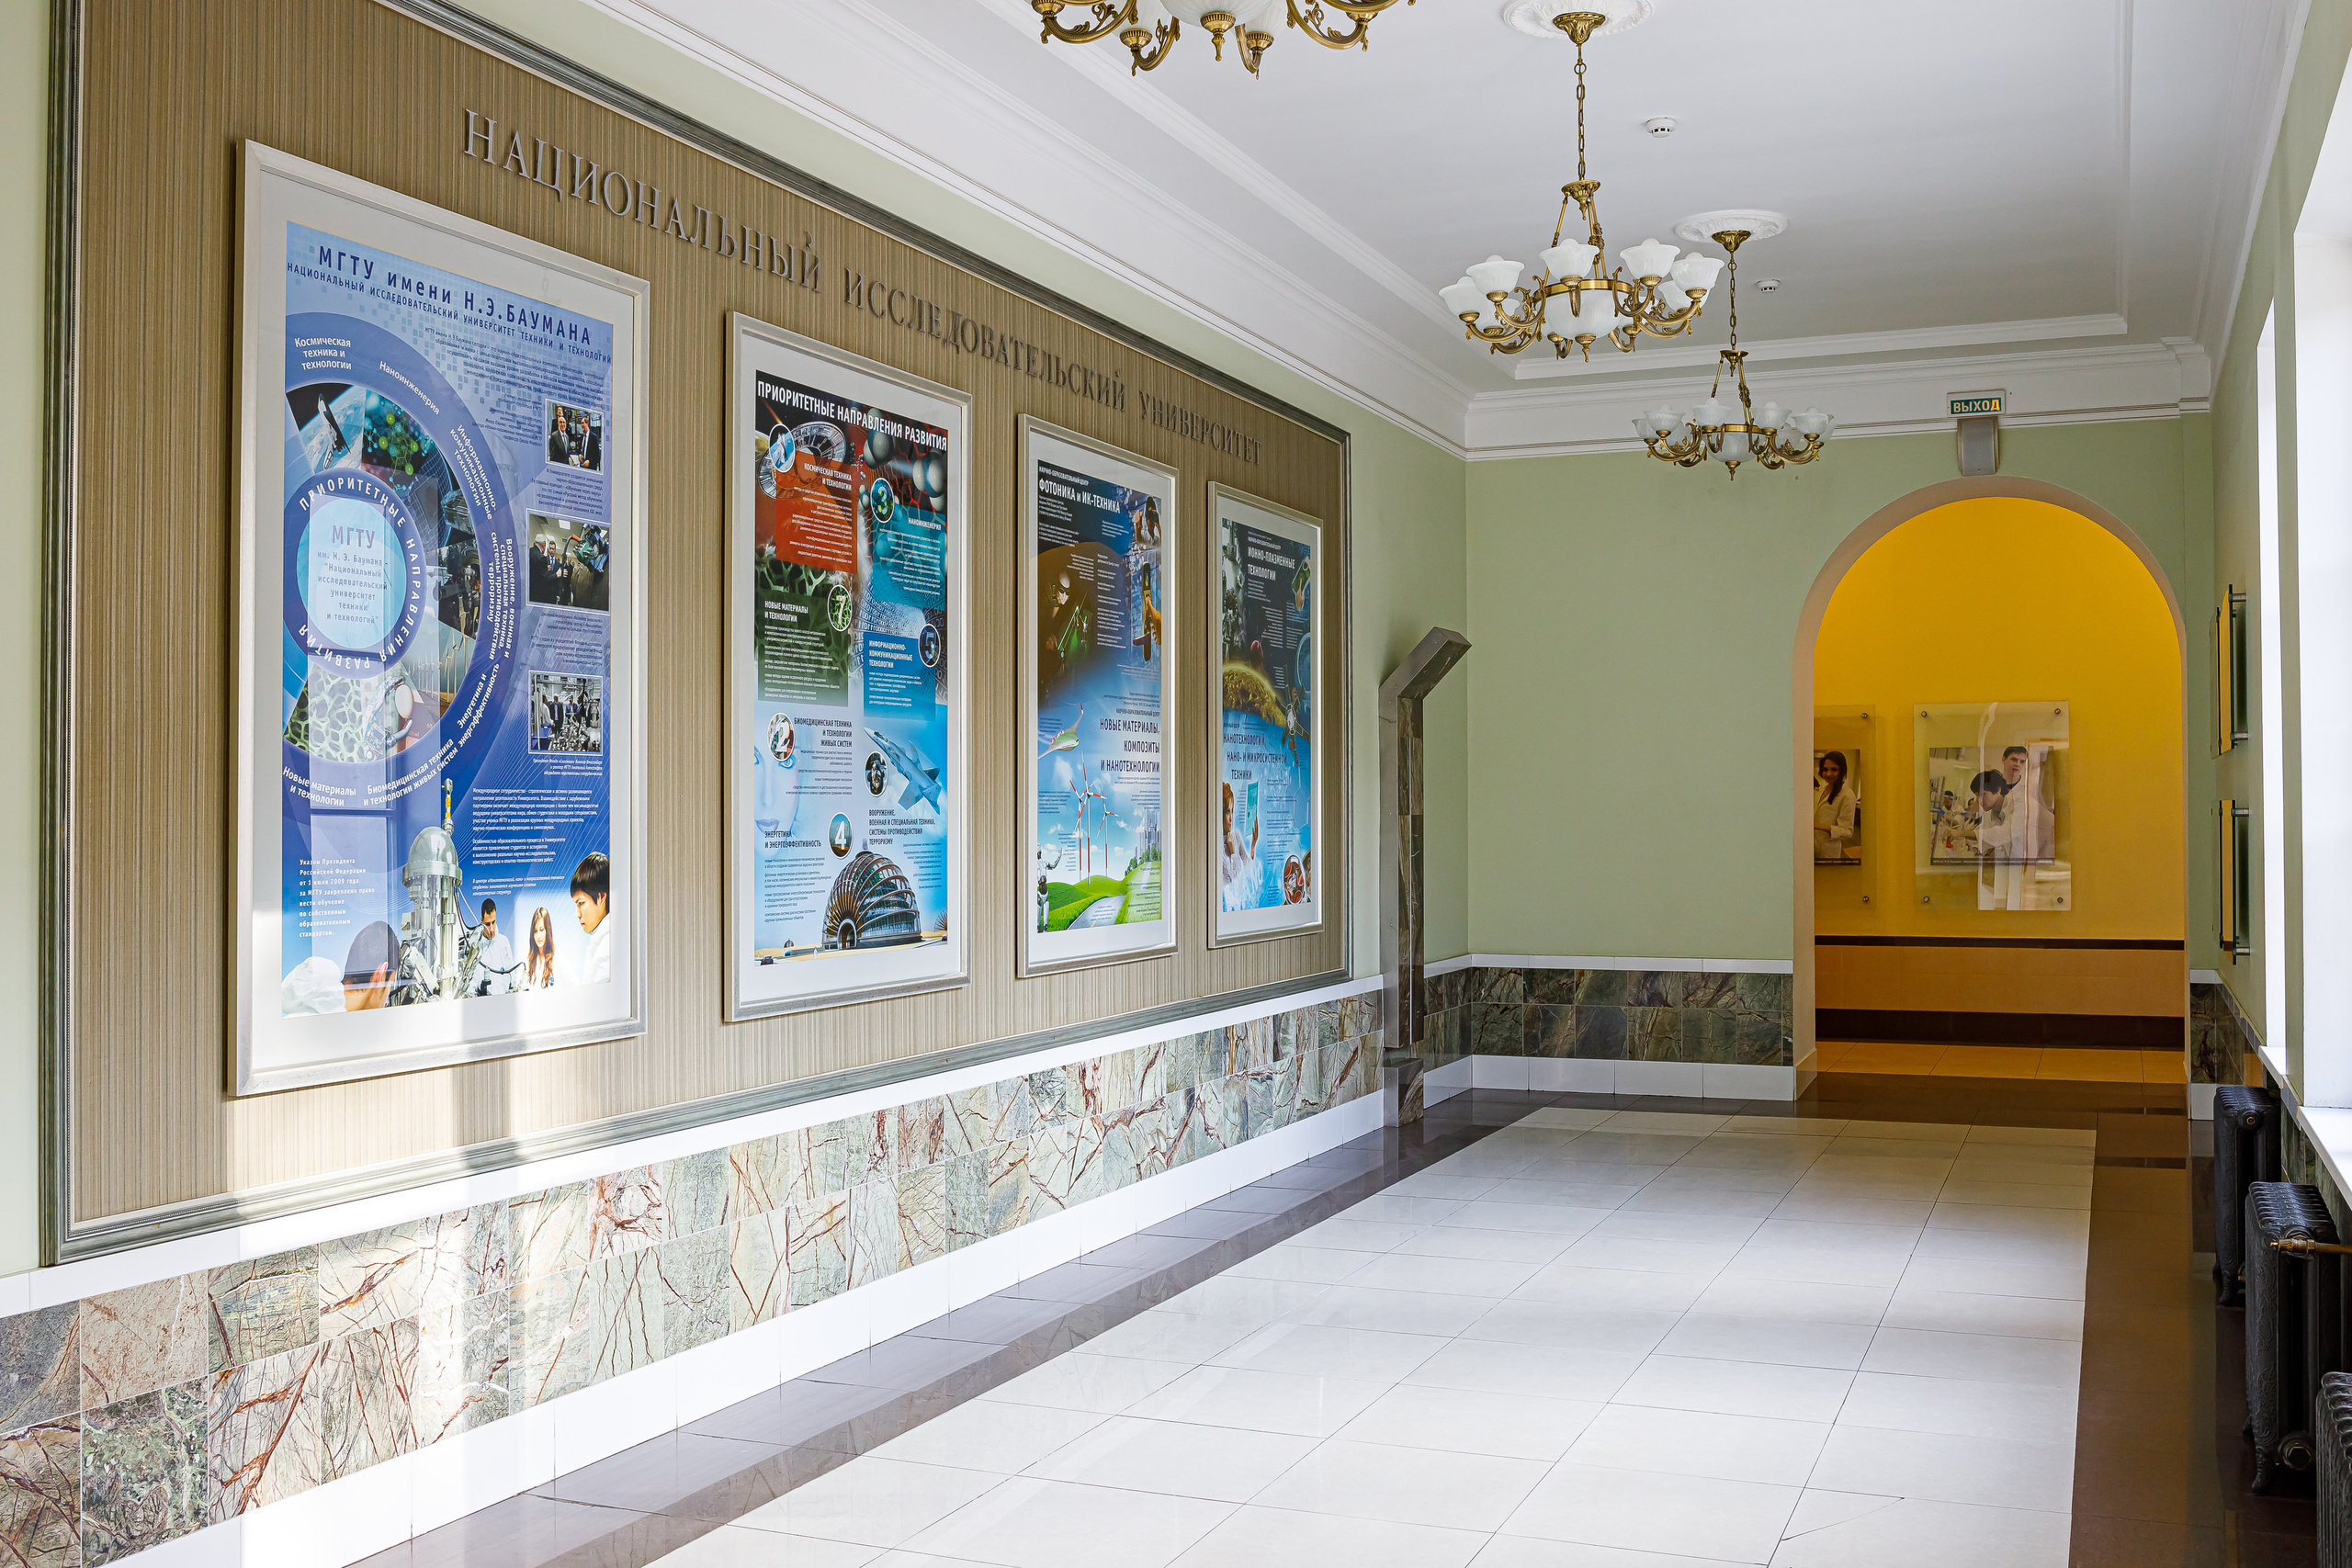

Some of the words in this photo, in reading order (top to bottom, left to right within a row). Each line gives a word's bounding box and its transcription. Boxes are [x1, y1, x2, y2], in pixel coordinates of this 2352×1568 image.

[319, 245, 374, 279] МГТУ
[388, 272, 451, 305] имени
[464, 290, 591, 345] Н.Э.БАУМАНА
[464, 107, 822, 293] НАЦИОНАЛЬНЫЙ
[844, 268, 1126, 412] ИССЛЕДОВАТЕЛЬСКИЙ
[1138, 389, 1263, 466] УНИВЕРСИТЕТ
[287, 262, 365, 292] НАЦИОНАЛЬНЫЙ
[370, 287, 458, 321] ИССЛЕДОВАТЕЛЬСКИЙ
[463, 314, 515, 337] УНИВЕРСИТЕТ
[521, 332, 553, 348] ТЕХНИКИ
[568, 344, 612, 365] ТЕХНОЛОГИЙ
[294, 337, 351, 348] Космическая
[303, 347, 338, 358] техника
[339, 349, 345, 358] и
[301, 360, 352, 370] технологии
[379, 360, 440, 415] Наноинженерия
[757, 380, 835, 419] ПРИОРИТЕТНЫЕ
[837, 405, 902, 439] НАПРАВЛЕНИЯ
[905, 425, 947, 451] РАЗВИТИЯ
[1953, 400, 2000, 412] ВЫХОД
[450, 429, 492, 520] комуникационные
[454, 449, 481, 507] технологии
[457, 424, 496, 511] Информационно-
[804, 462, 834, 477] КОСМИЧЕСКАЯ
[834, 468, 852, 481] ТЕХНИКА
[827, 479, 852, 491] ТЕХНОЛОГИИ
[1039, 478, 1076, 502] ФОТОНИКА
[1082, 491, 1121, 513] ИК-ТЕХНИКА
[299, 477, 407, 528] ПРИОРИТЕТНЫЕ
[908, 517, 942, 531] НАНОИНЖЕНЕРИЯ
[332, 525, 375, 549] МГТУ
[353, 555, 383, 567] Баумана
[491, 532, 501, 573] системы
[1248, 547, 1295, 570] ИОННО-ПЛАЗМЕННЫЕ
[500, 544, 508, 607] специальная
[506, 538, 515, 604] Вооружение,
[317, 576, 388, 590] исследовательский
[486, 562, 494, 623] терроризму
[331, 589, 376, 601] университет
[338, 602, 368, 611] техники
[379, 537, 422, 662] НАПРАВЛЕНИЯ
[489, 576, 502, 660] противодействия
[764, 600, 781, 610] НОВЫЕ
[782, 602, 808, 614] МАТЕРИАЛЫ
[769, 611, 797, 623] ТЕХНОЛОГИИ
[506, 608, 515, 649] военная
[298, 624, 370, 670] РАЗВИТИЯ
[457, 682, 483, 729] Энергетика
[481, 673, 487, 682] и
[794, 717, 834, 728] БИОМЕДИЦИНСКАЯ
[834, 720, 852, 728] ТЕХНИКА
[827, 729, 853, 738] ТЕХНОЛОГИИ
[1100, 718, 1121, 731] НОВЫЕ
[1122, 720, 1159, 735] МАТЕРИАЛЫ,
[775, 721, 790, 752] 2
[1124, 740, 1159, 753] КОМПОЗИТЫ
[368, 762, 429, 795] Биомедицинская
[429, 739, 454, 766] техника
[1101, 760, 1105, 771] И
[1106, 760, 1159, 773] НАНОТЕХНОЛОГИИ
[1247, 751, 1287, 764] МИКРОСИСТЕМНОЙ
[283, 766, 310, 787] Новые
[311, 781, 356, 795] материалы
[363, 798, 368, 807] и
[370, 786, 413, 806] технологии
[413, 770, 437, 790] живых
[437, 747, 459, 772] систем
[1231, 769, 1252, 780] ТЕХНИКИ
[289, 784, 296, 793] и
[298, 788, 345, 807] технологии
[869, 828, 887, 836] СИСТЕМЫ
[888, 827, 922, 836] ПРОТИВОДЕЙСТВИЯ
[891, 818, 918, 827] СПЕЦИАЛЬНАЯ
[769, 840, 822, 849] ЭНЕРГОЭФФЕКТИВНОСТЬ
[834, 820, 847, 851] 4
